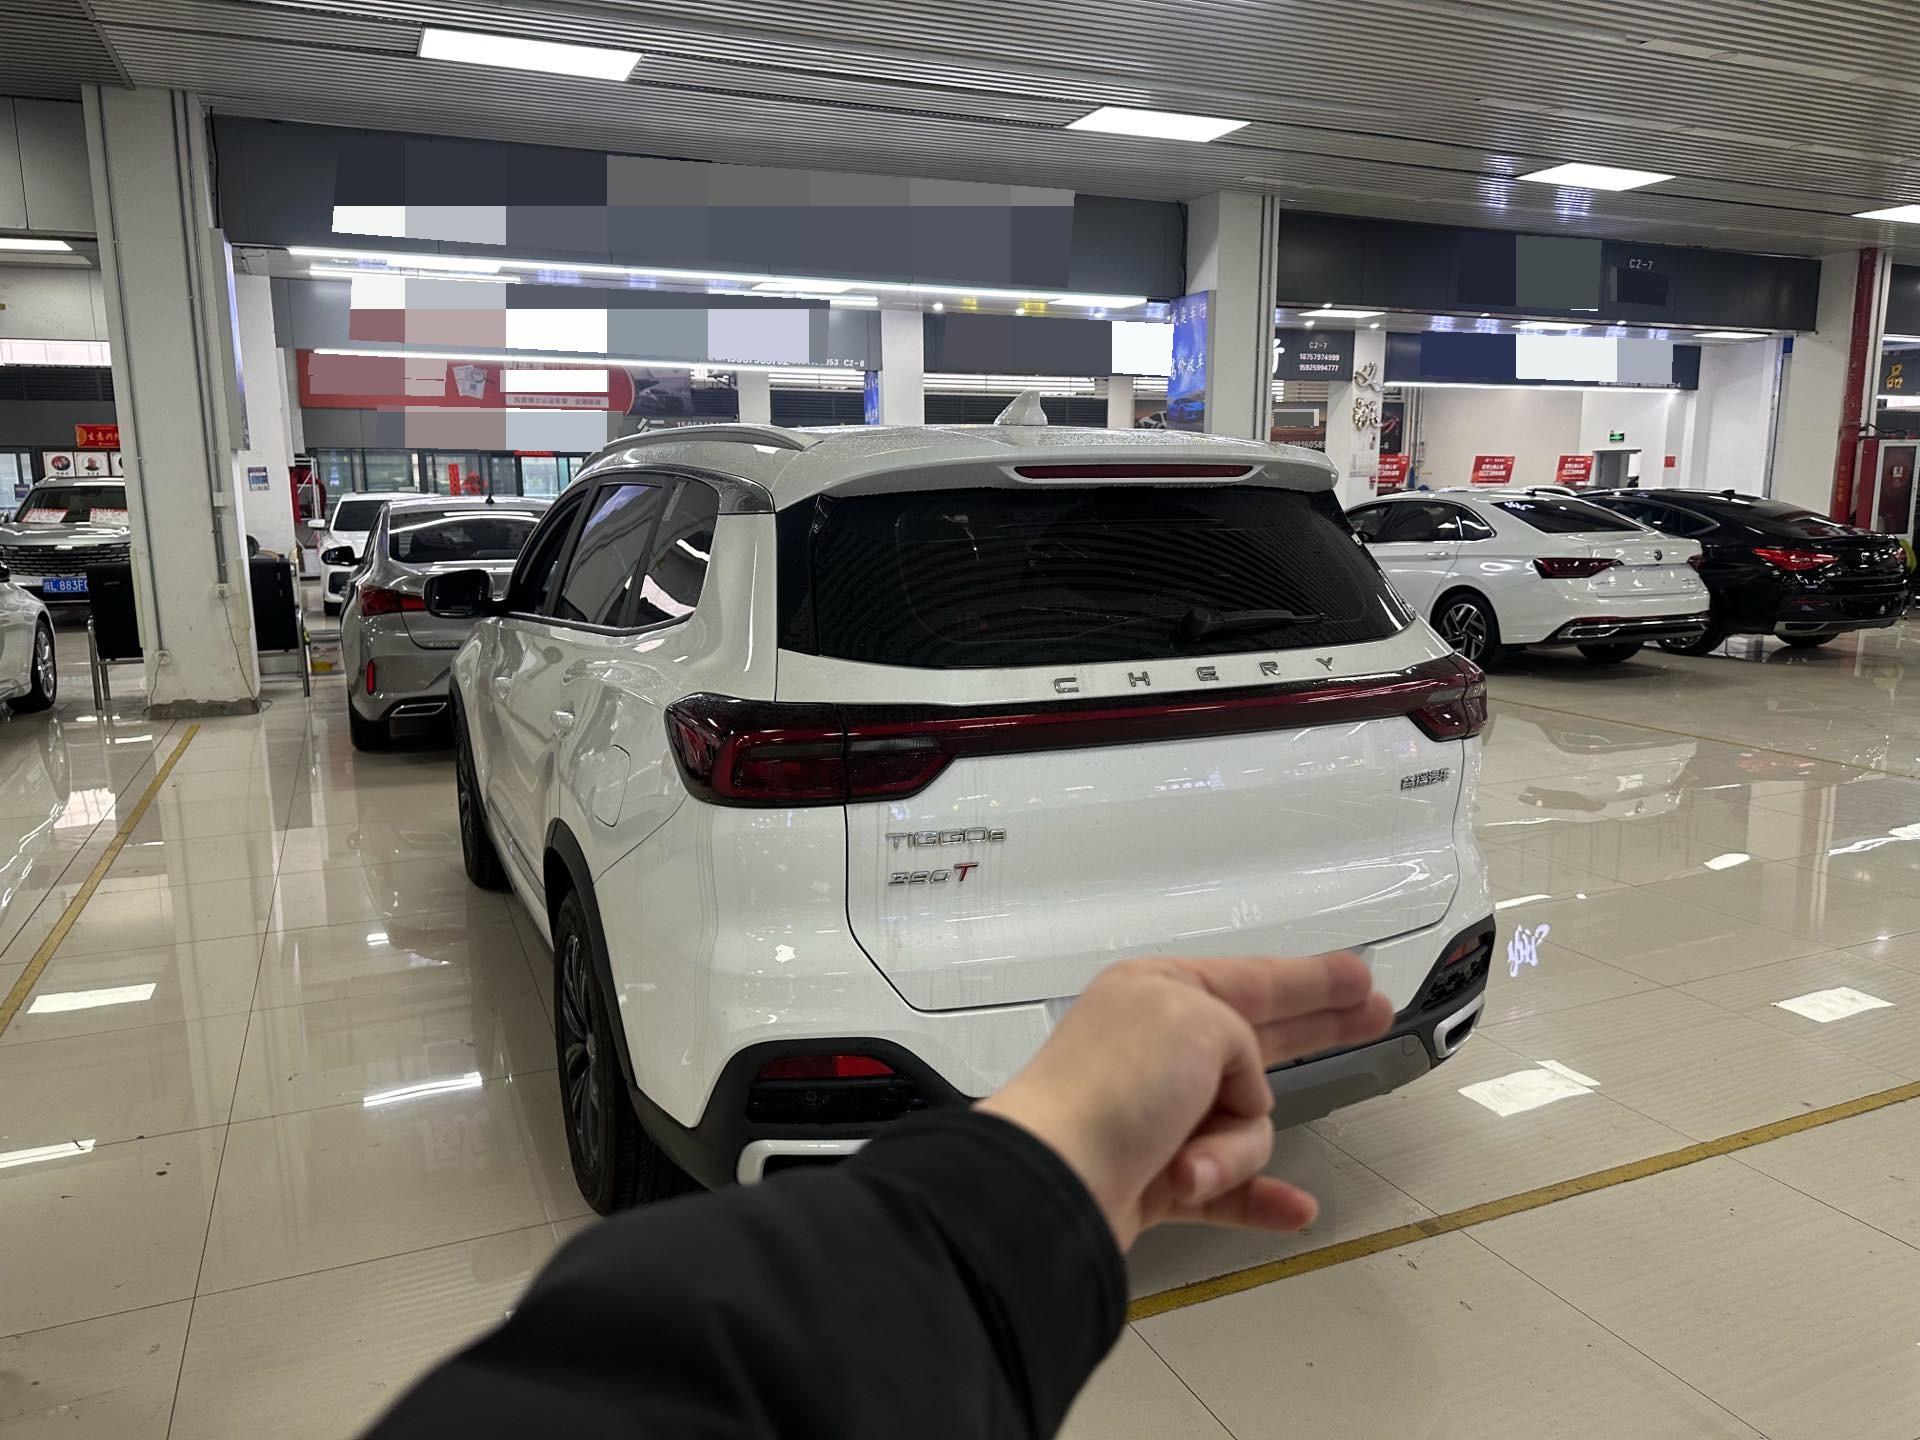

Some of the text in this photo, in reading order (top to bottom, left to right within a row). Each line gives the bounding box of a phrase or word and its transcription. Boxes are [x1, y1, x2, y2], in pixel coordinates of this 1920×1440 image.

[1629, 258, 1653, 270] C2-7
[1308, 341, 1328, 349] C2-7
[1053, 656, 1334, 694] CHERY
